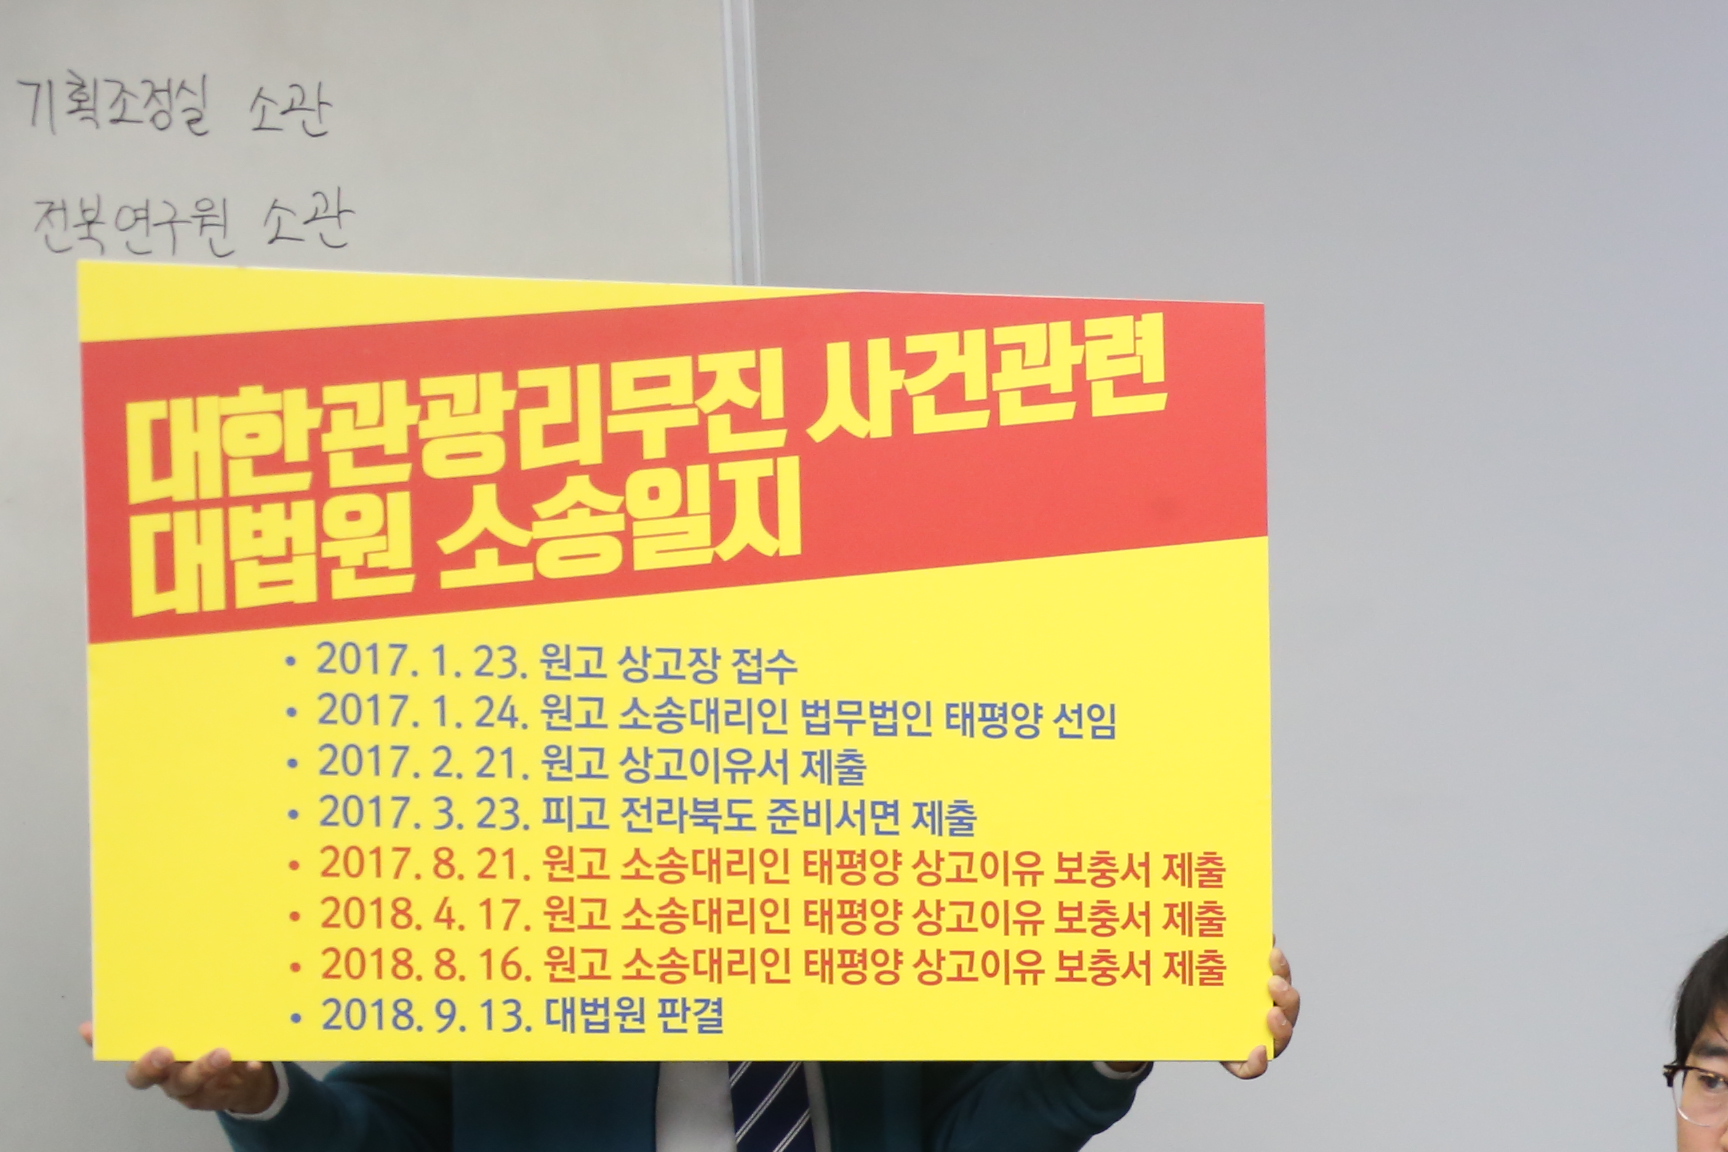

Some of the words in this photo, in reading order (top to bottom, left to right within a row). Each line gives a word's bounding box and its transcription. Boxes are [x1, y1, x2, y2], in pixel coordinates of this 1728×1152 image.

[17, 70, 210, 137] 기획조정실
[250, 80, 334, 138] 소관
[33, 193, 235, 258] 전북연구원
[263, 186, 356, 250] 소관
[127, 348, 787, 504] 대한관광리무진
[808, 312, 1168, 442] 사건관련
[130, 491, 415, 616] 대법원
[437, 456, 801, 588] 소송일지
[316, 640, 419, 678] 2017.
[432, 643, 462, 678] 1.
[473, 644, 528, 680] 23.
[539, 643, 608, 681] 원고
[617, 645, 722, 685] 상고장
[731, 647, 798, 686] 접수
[317, 691, 419, 728] 2017.
[433, 694, 463, 729] 1.
[475, 694, 529, 730] 24.
[540, 693, 609, 732] 원고
[618, 696, 788, 735] 소송대리인
[801, 699, 933, 738] 법무법인
[945, 701, 1044, 740] 태평양
[1052, 703, 1116, 740] 선임
[318, 742, 420, 779] 2017.
[432, 744, 463, 780] 2.
[475, 745, 529, 781] 21.
[541, 744, 609, 782] 원고
[619, 746, 789, 786] 상고이유서
[800, 748, 867, 787] 제출
[319, 794, 421, 830] 2017.
[433, 795, 464, 831] 3.
[476, 796, 530, 831] 23.
[542, 795, 610, 833] 피고
[620, 796, 757, 835] 전라북도
[766, 798, 900, 836] 준비서면
[911, 799, 978, 838] 제출
[320, 844, 422, 881] 2017.
[432, 846, 465, 881] 8.
[477, 846, 531, 882] 21.
[542, 844, 611, 883] 원고
[620, 846, 790, 885] 소송대리인
[803, 848, 903, 887] 태평양
[911, 849, 1045, 888] 상고이유
[1053, 850, 1151, 889] 보충서
[1161, 851, 1227, 889] 제출
[320, 895, 423, 931] 2018.
[433, 896, 466, 932] 4.
[479, 897, 532, 932] 17.
[543, 895, 612, 933] 원고
[621, 896, 791, 935] 소송대리인
[803, 898, 904, 937] 태평양
[911, 898, 1045, 937] 상고이유
[1054, 899, 1151, 938] 보충서
[1161, 900, 1227, 938] 제출
[321, 946, 423, 982] 2018.
[434, 947, 466, 982] 8.
[479, 946, 532, 983] 16.
[543, 945, 612, 984] 원고
[621, 946, 791, 985] 소송대리인
[804, 947, 904, 986] 태평양
[912, 948, 1046, 987] 상고이유
[1054, 948, 1151, 987] 보충서
[1162, 949, 1228, 987] 제출
[322, 997, 424, 1033] 2018.
[434, 998, 467, 1034] 9.
[480, 998, 533, 1033] 13.
[545, 996, 646, 1034] 대법원
[657, 996, 724, 1035] 판결
